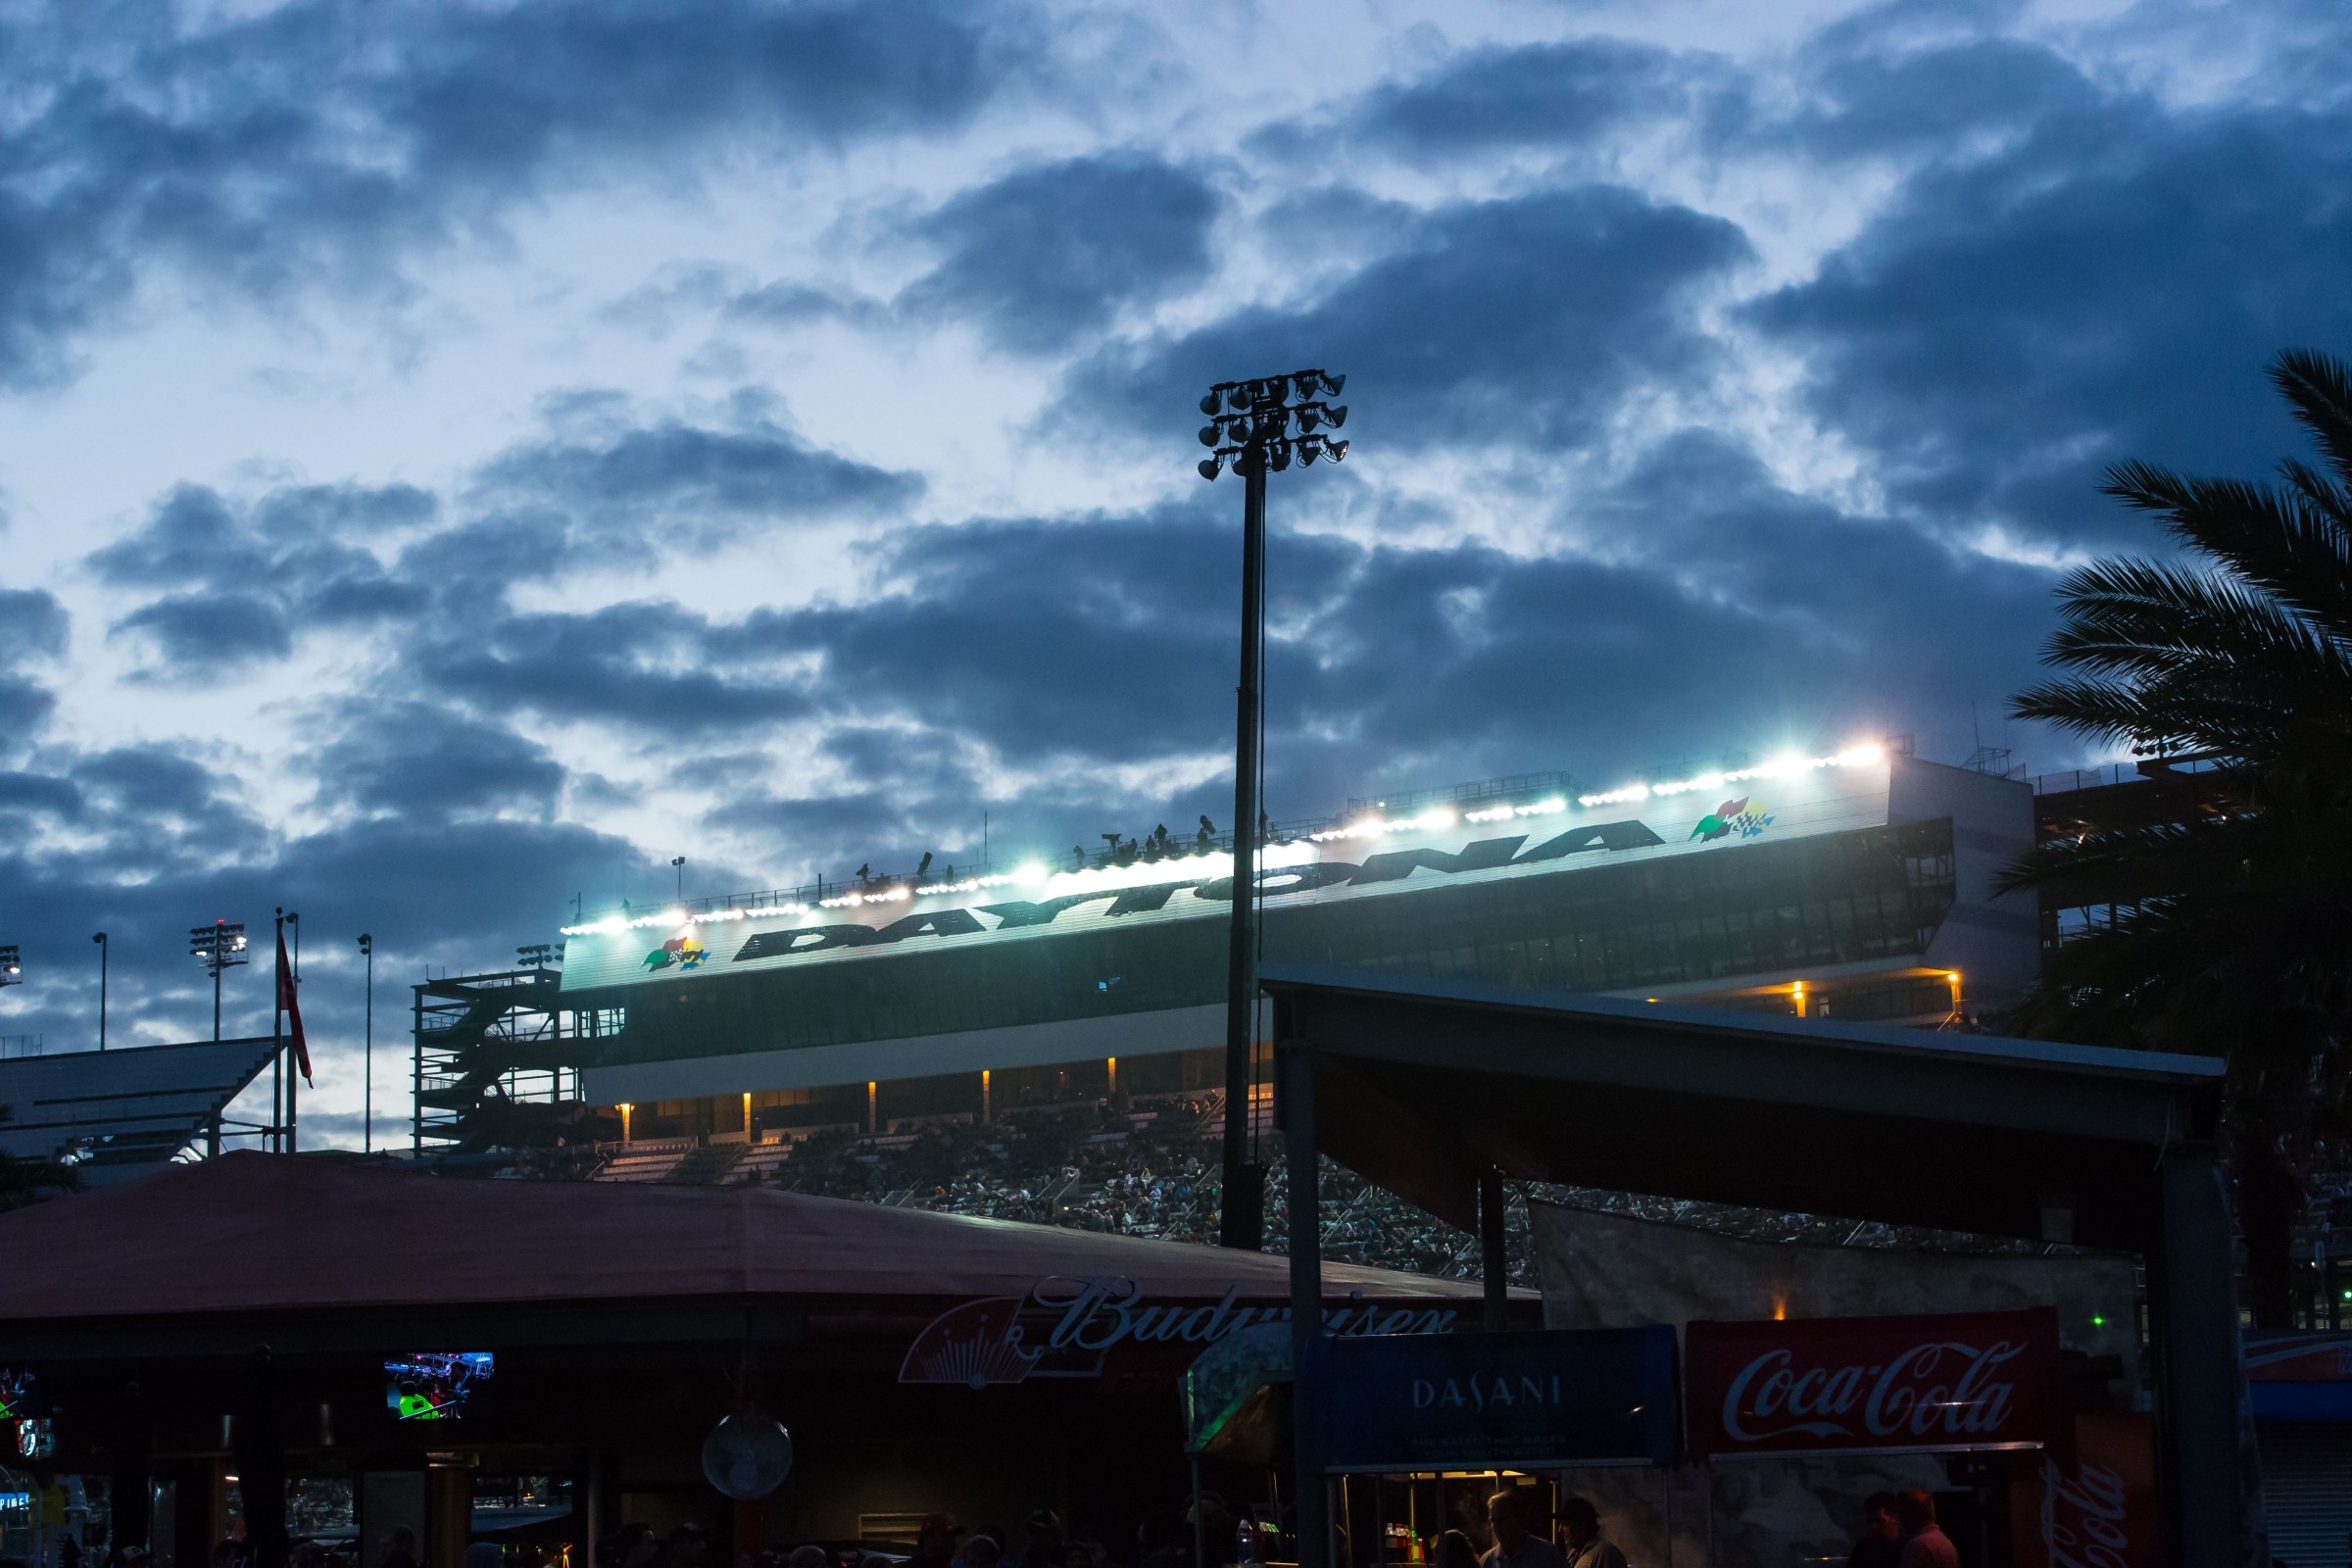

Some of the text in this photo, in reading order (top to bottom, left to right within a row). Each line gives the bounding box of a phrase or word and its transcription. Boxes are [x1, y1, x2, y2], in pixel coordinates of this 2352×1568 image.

[733, 819, 1666, 962] DAYTONA
[1032, 1275, 1458, 1349] Budiser
[1413, 1374, 1561, 1414] DASANI
[1722, 1340, 2029, 1443] Coca-Cola
